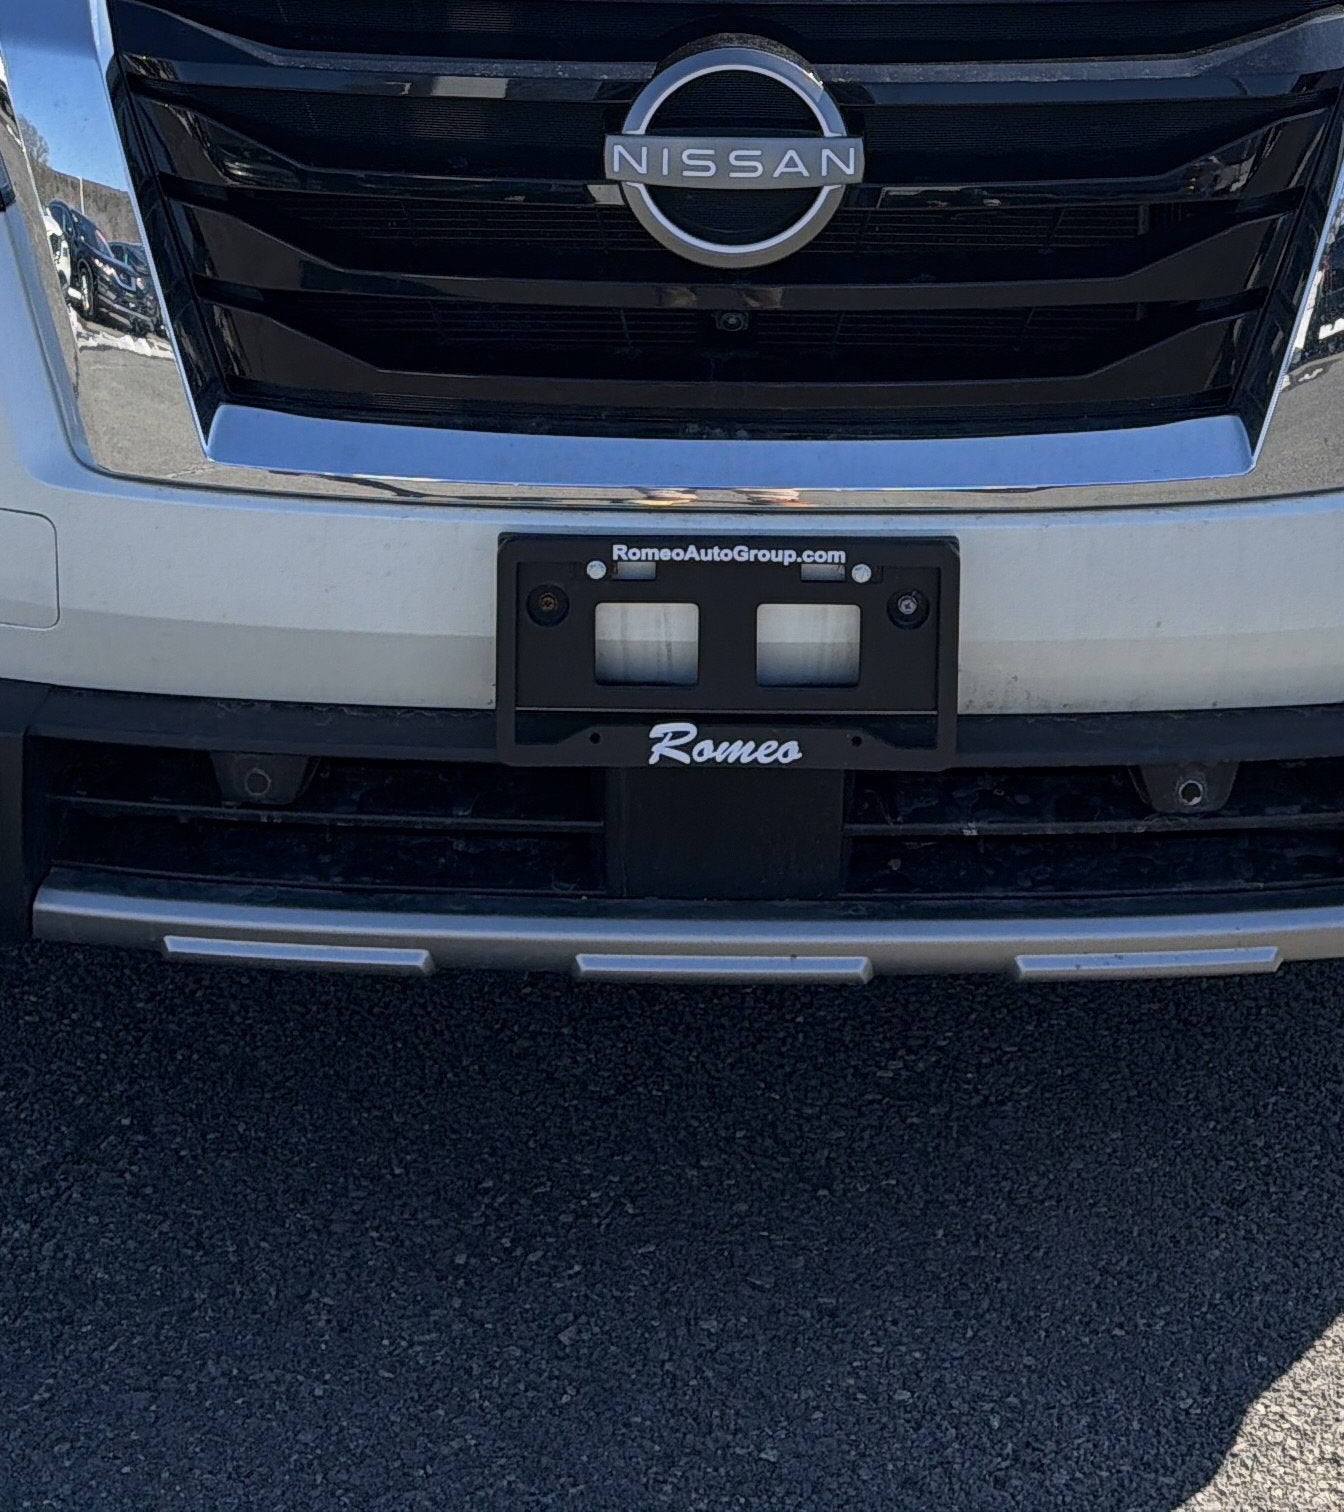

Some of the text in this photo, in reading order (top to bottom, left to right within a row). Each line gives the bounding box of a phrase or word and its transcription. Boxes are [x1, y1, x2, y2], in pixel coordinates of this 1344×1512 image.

[612, 144, 856, 179] NISSAN
[612, 544, 846, 566] RomeoAutoGroup.com
[648, 722, 803, 765] Romeo
